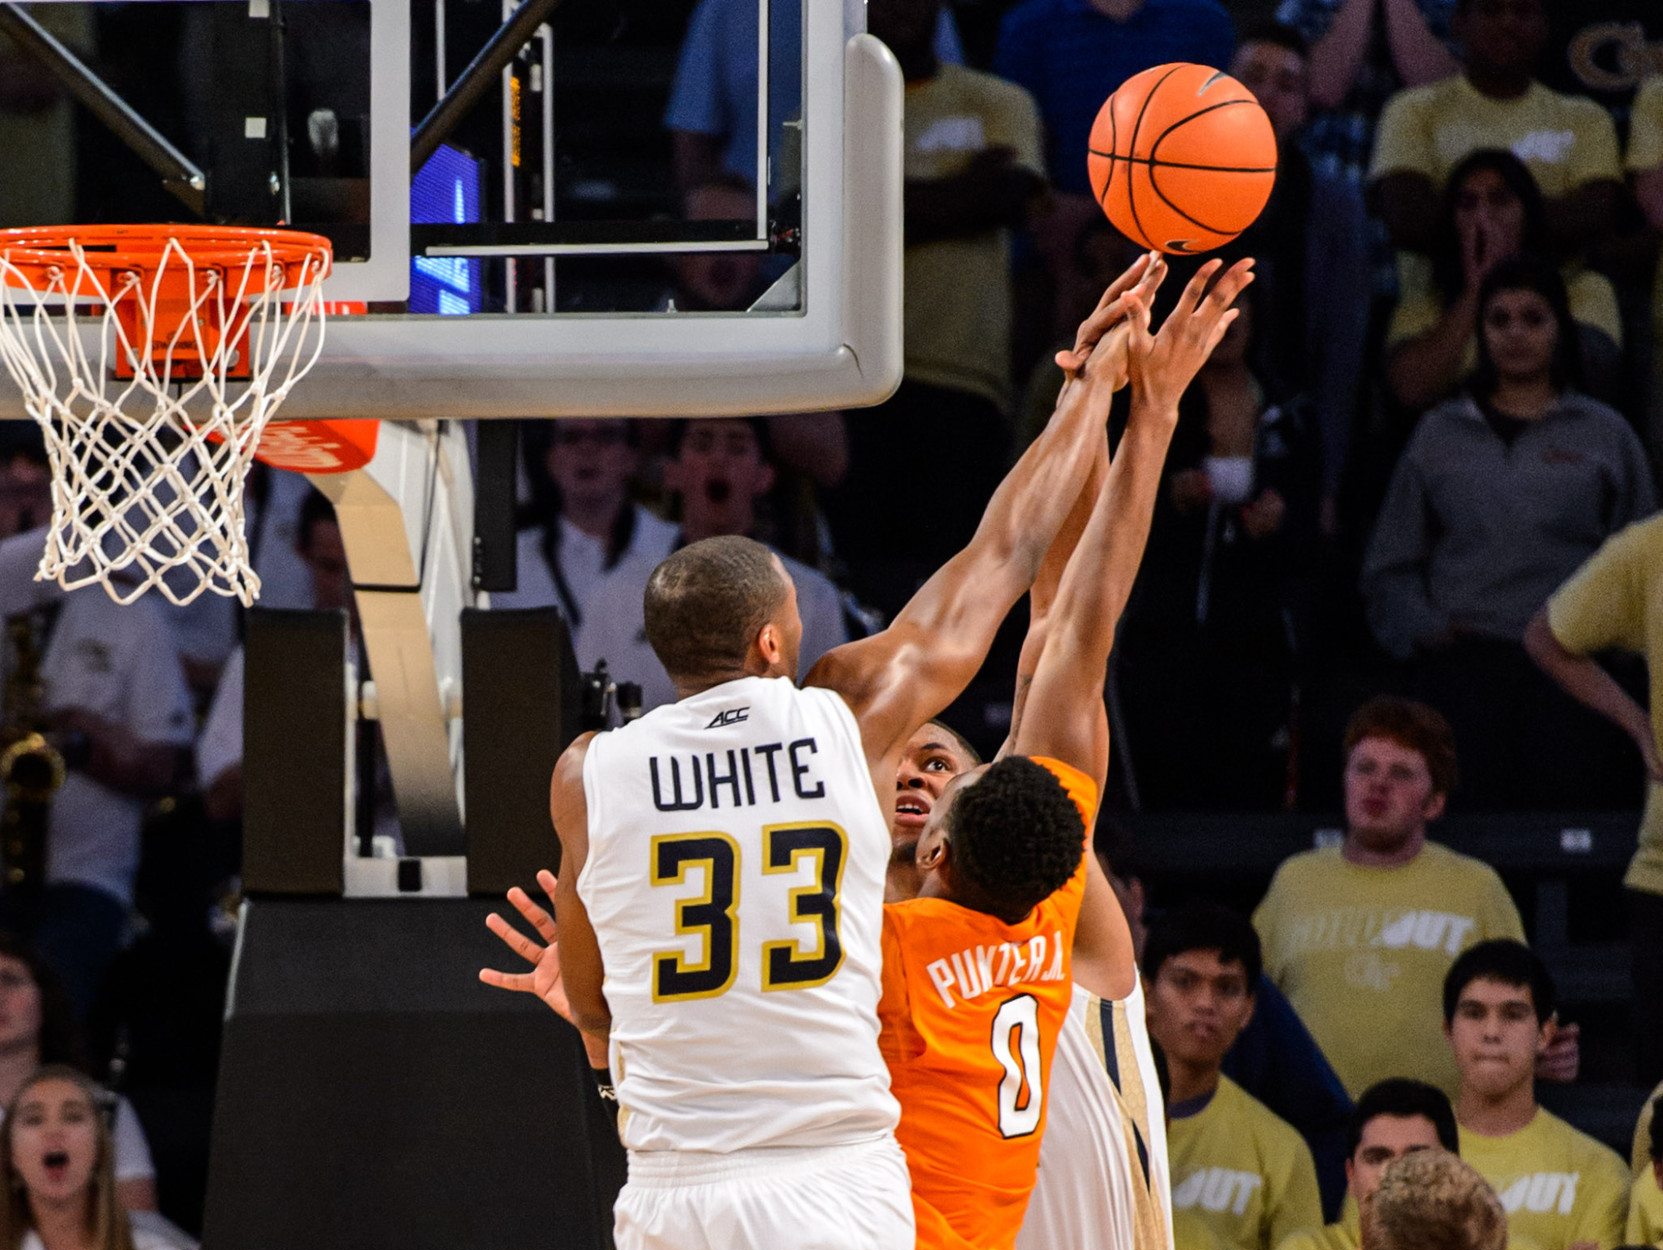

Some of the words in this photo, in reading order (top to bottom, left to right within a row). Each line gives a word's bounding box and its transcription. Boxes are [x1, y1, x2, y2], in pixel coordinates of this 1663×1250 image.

[705, 707, 750, 730] ACC
[649, 737, 826, 812] WHITE
[650, 820, 849, 1004] 33
[991, 992, 1044, 1140] 0
